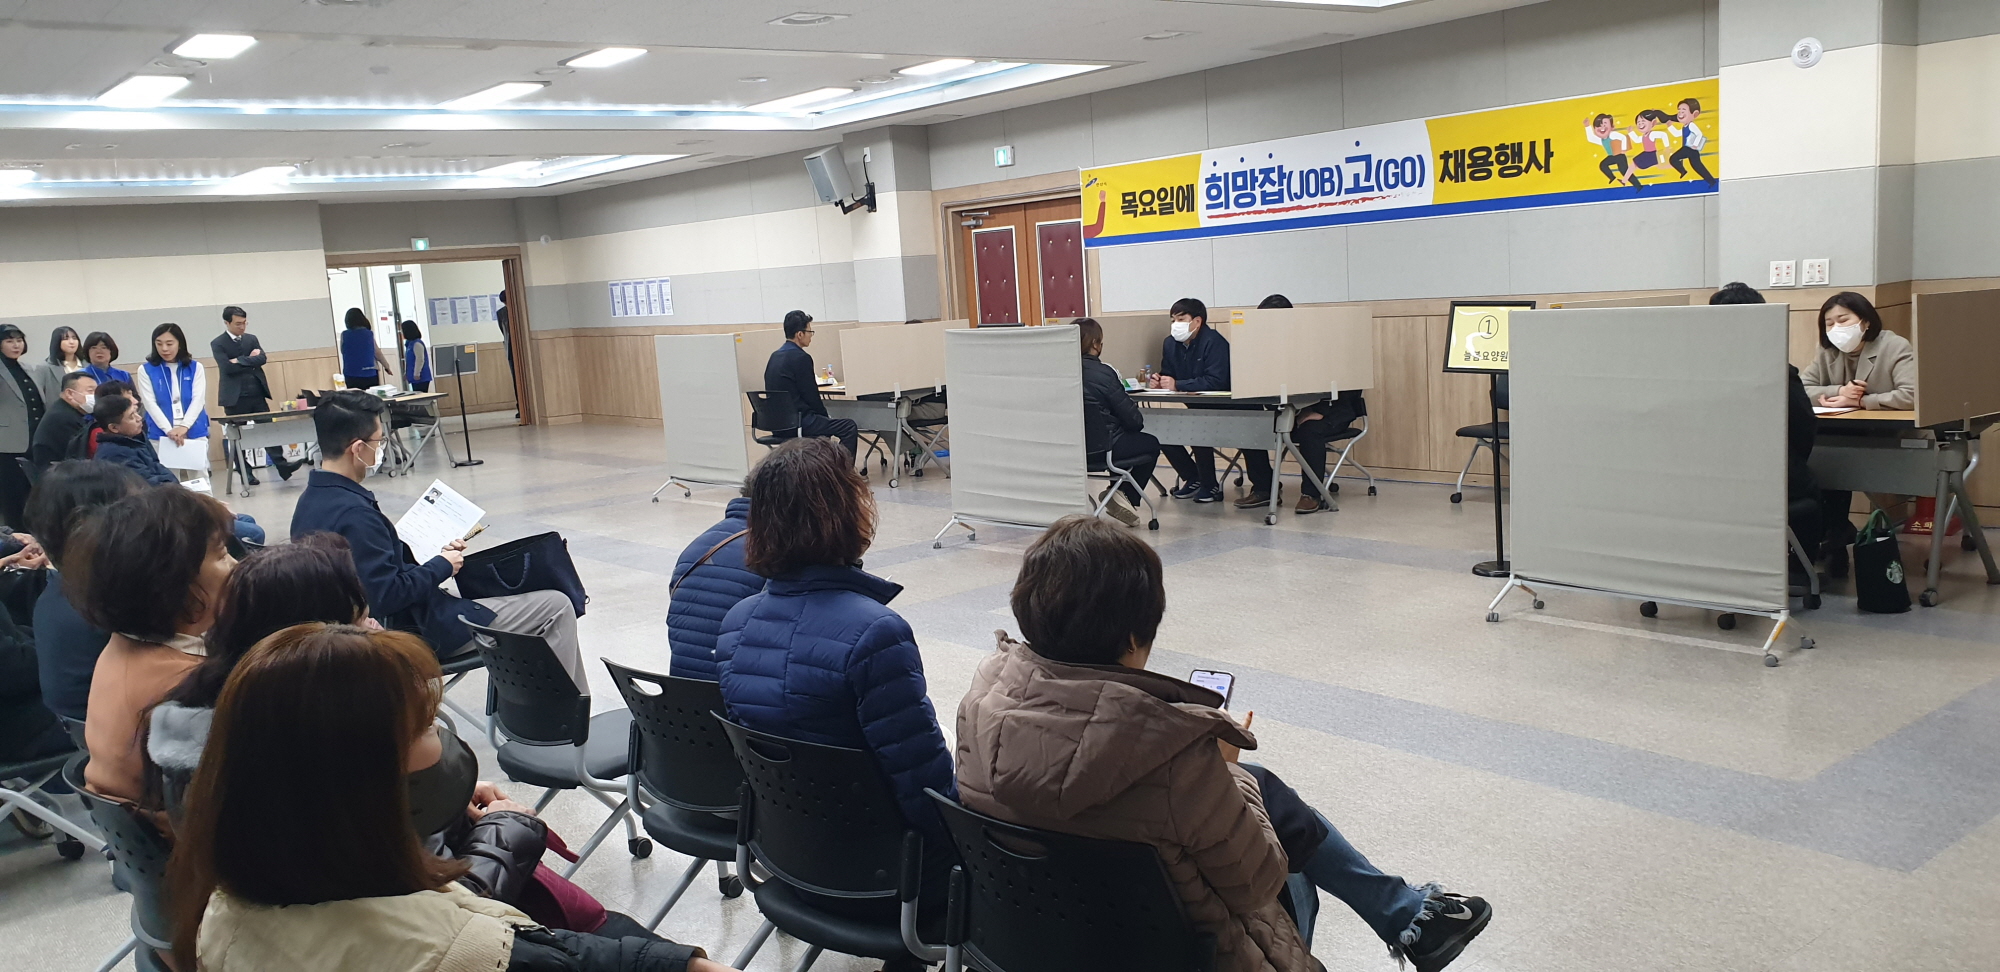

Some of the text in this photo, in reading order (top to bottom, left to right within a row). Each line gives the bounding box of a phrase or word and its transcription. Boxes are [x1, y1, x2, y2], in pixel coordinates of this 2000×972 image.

[1120, 183, 1195, 218] 목요일에
[1438, 138, 1554, 184] 채용행사
[1911, 521, 1933, 529] 소화
